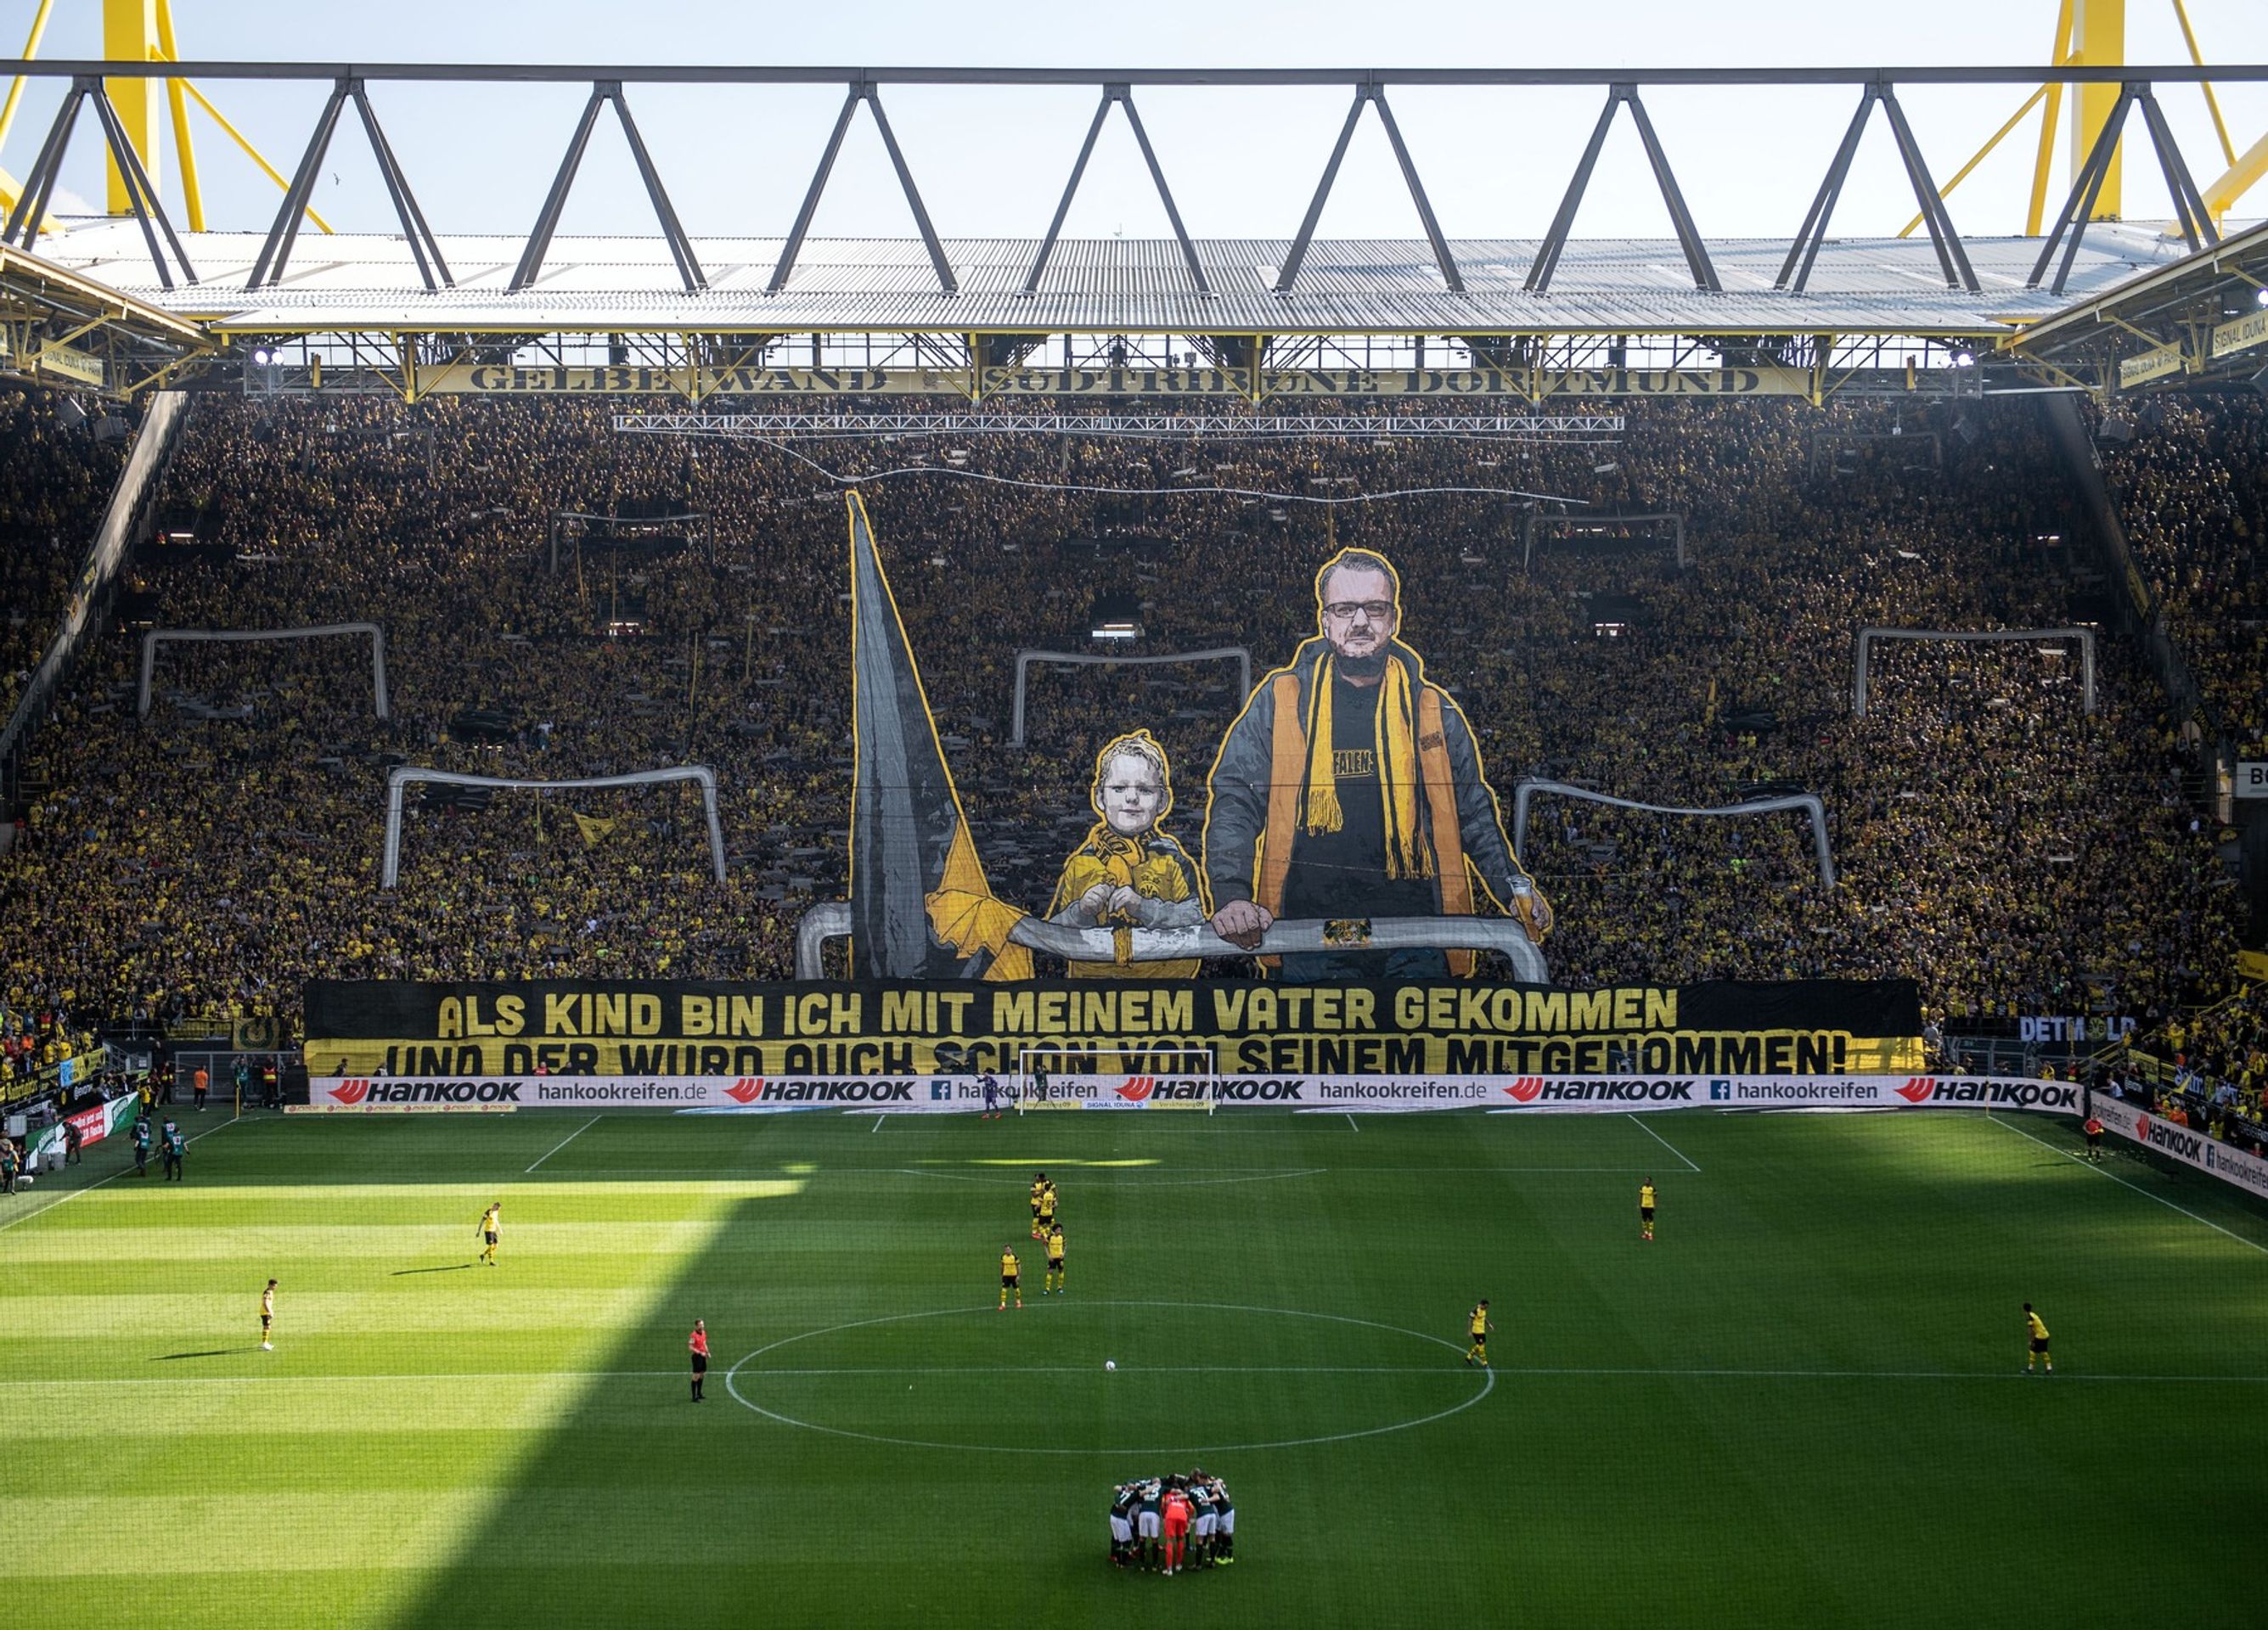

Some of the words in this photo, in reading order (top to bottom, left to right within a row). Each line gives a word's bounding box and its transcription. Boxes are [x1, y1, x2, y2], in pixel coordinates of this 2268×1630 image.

[2215, 327, 2241, 350] SIGNAL
[2243, 318, 2266, 340] IDUNA
[470, 367, 673, 391] GELBE
[708, 367, 888, 391] WAND
[984, 368, 1379, 392] SÜDTRIBÜNE
[1404, 368, 1759, 393] DORTMUND
[438, 995, 526, 1037] ALS
[545, 993, 662, 1037] KIND
[682, 995, 763, 1037] BIN
[783, 992, 861, 1035] ICH
[881, 990, 975, 1033] MIT
[993, 989, 1193, 1033] MEINEM
[1213, 987, 1376, 1032] VATER
[1394, 986, 1678, 1031] GEKOMMEN
[387, 1045, 483, 1076] UND
[504, 1043, 599, 1076] DER
[784, 1043, 914, 1076] AUCH
[934, 1042, 1097, 1076] SCHON
[1117, 1041, 1209, 1075] VON
[1238, 1039, 1425, 1074] SEINEM
[1446, 1035, 1846, 1075] MITGENOMMEN!
[538, 1082, 706, 1099] hankookreifen.de
[1320, 1081, 1487, 1098] hankookreifen.de
[1738, 1081, 1877, 1099] hankookreifen
